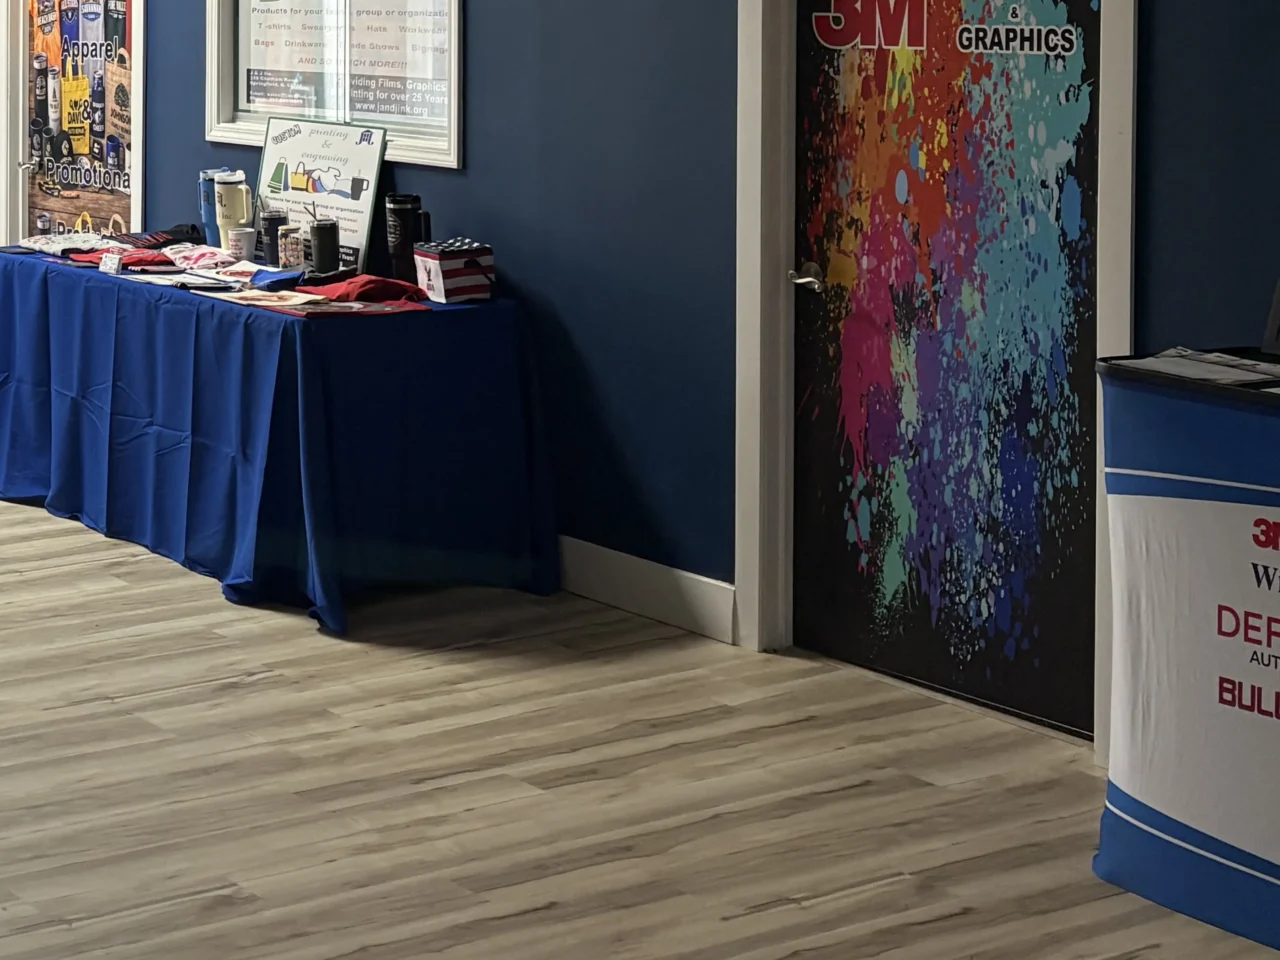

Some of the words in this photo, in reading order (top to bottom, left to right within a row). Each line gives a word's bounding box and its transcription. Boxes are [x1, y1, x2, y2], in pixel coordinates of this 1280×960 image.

[251, 7, 288, 16] Products
[289, 7, 302, 15] for
[304, 9, 324, 18] your
[356, 10, 383, 20] group
[366, 25, 388, 33] Hats
[254, 39, 275, 48] Bags
[368, 42, 400, 51] Shows
[958, 26, 1077, 53] GRAPHICS
[61, 35, 119, 65] Apparel
[297, 57, 317, 66] AND
[378, 78, 404, 89] Films,
[376, 90, 389, 100] for
[390, 93, 410, 102] over
[411, 93, 422, 102] 25
[81, 98, 93, 122] &
[355, 102, 428, 117] www.jandjink.org
[271, 124, 302, 145] CUSTOM
[1251, 562, 1280, 592] W
